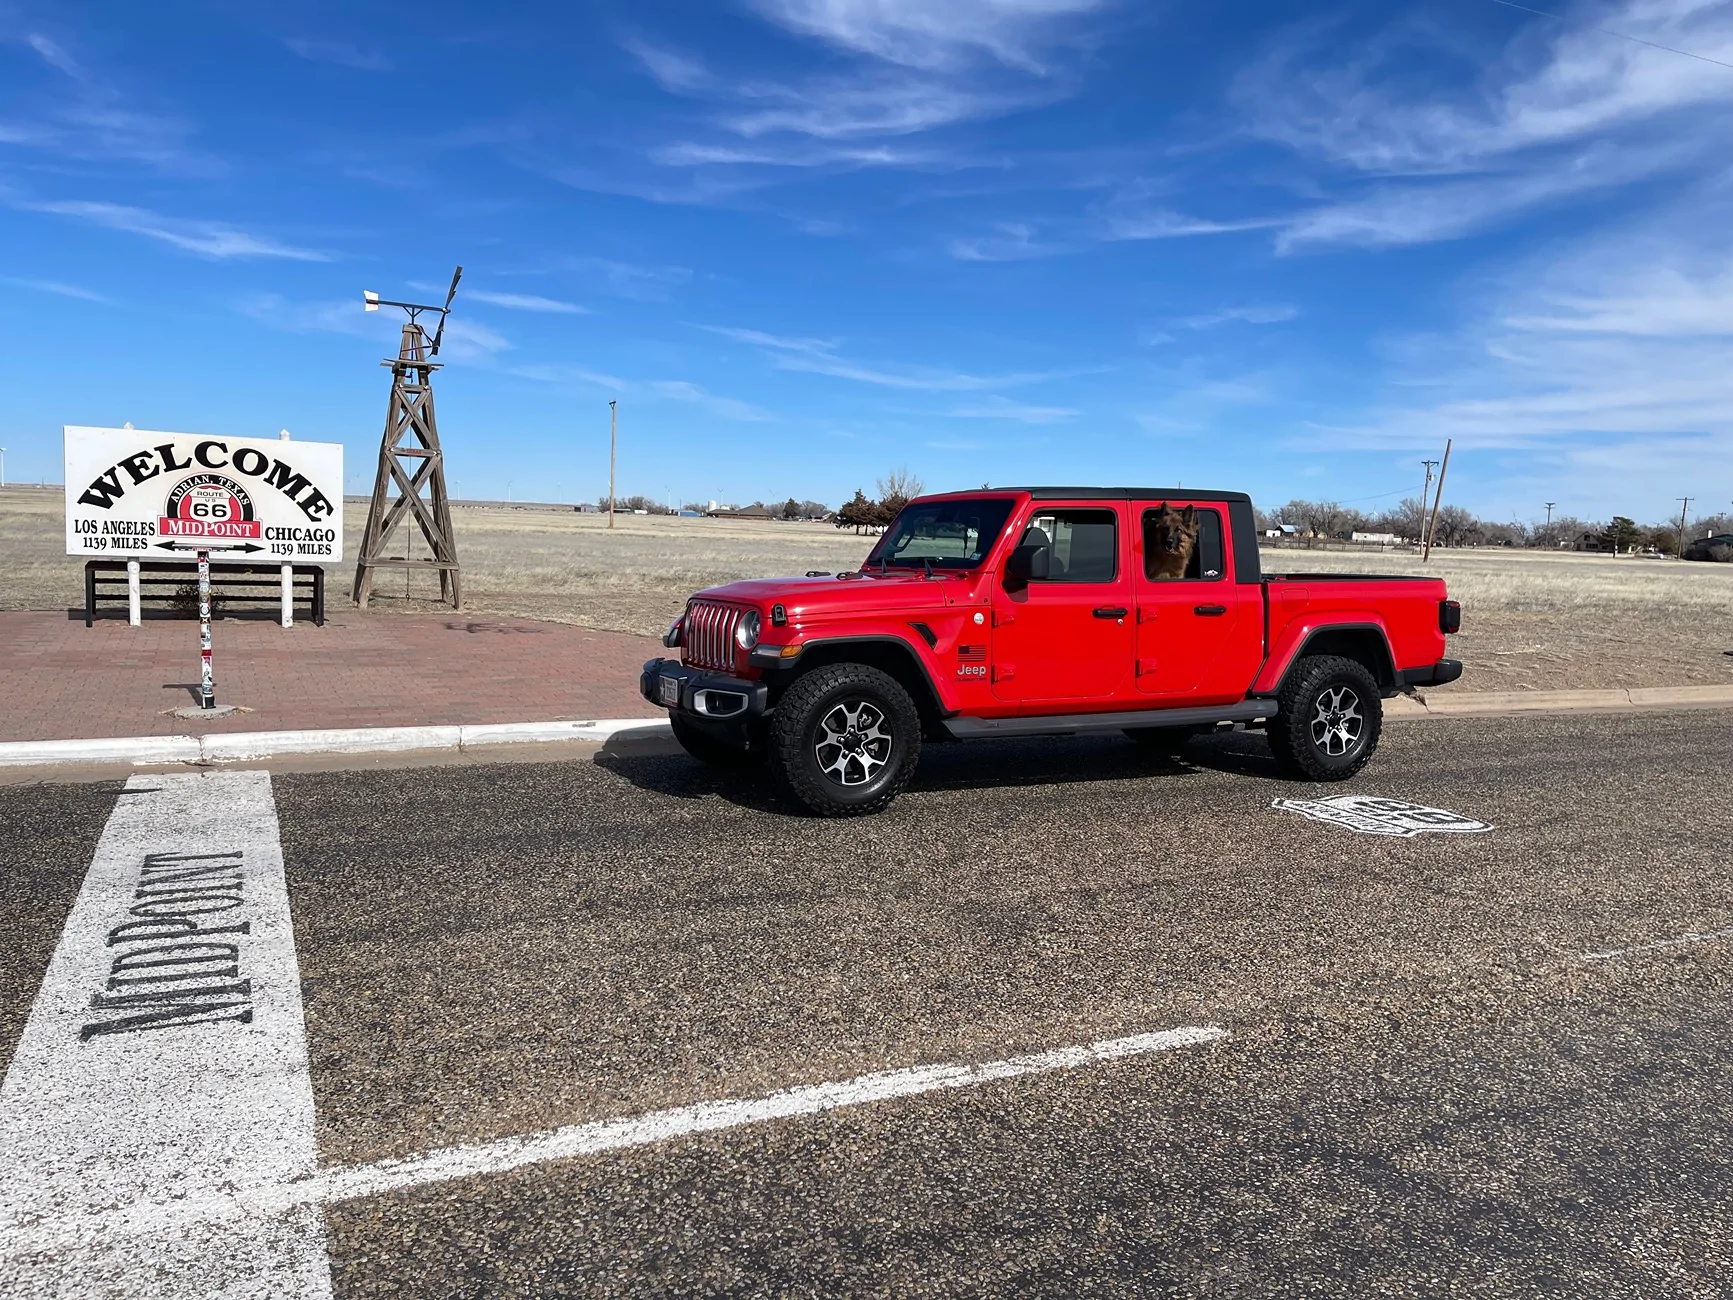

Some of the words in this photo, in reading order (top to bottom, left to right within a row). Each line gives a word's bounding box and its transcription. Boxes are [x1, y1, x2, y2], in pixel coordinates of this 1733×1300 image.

[77, 441, 334, 522] WELCOME
[171, 475, 213, 503] ADRIAN,
[219, 477, 249, 505] TEXAS
[193, 503, 227, 517] 66
[75, 519, 98, 533] LOS
[102, 520, 155, 536] ANGELES
[168, 520, 252, 536] MIDPOINT
[265, 527, 335, 542] CHICAGO
[83, 537, 107, 550] 1139
[111, 537, 148, 549] MILES
[271, 543, 293, 556] 1139
[298, 543, 332, 555] MILES
[957, 664, 986, 676] Jeep
[79, 851, 253, 1042] MIDPOINT
